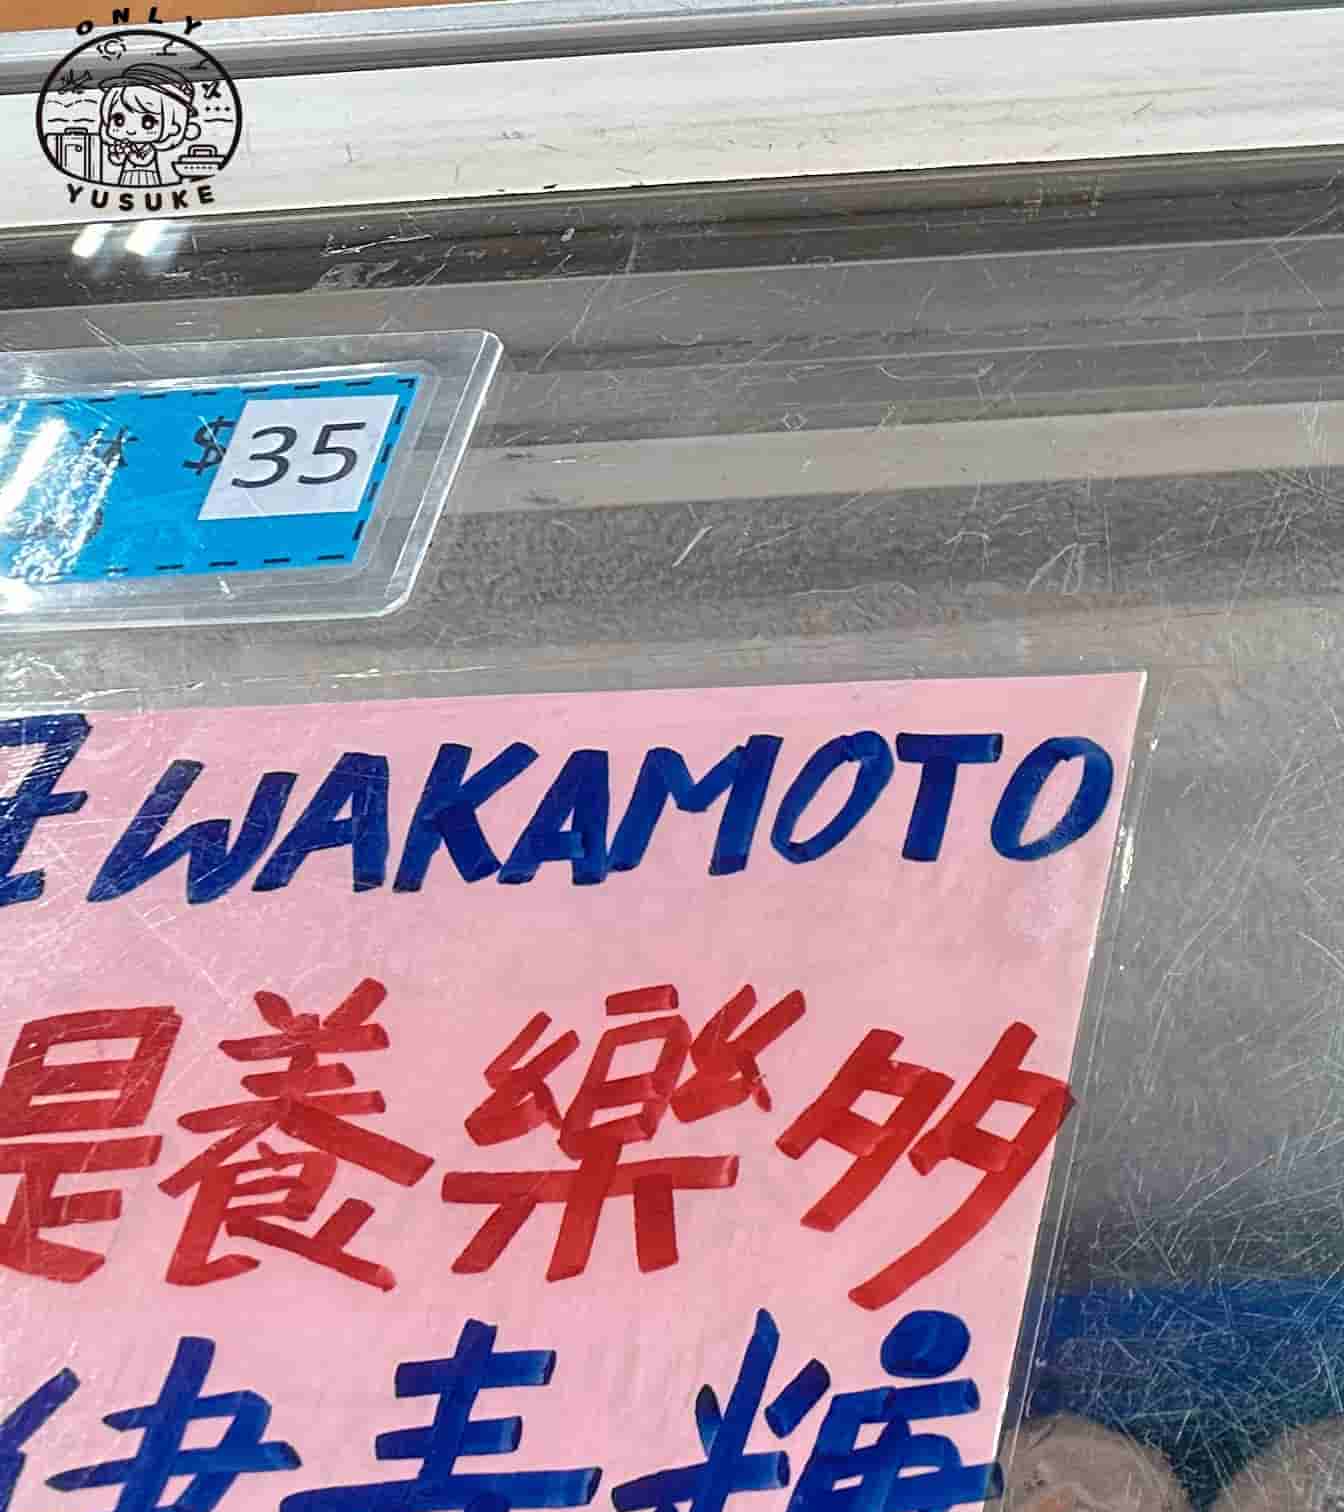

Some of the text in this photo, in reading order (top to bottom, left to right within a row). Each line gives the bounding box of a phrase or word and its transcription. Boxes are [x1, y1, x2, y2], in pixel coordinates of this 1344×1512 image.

[86, 729, 1114, 904] WAKAMOTO
[0, 975, 1075, 1310] 是養樂多
